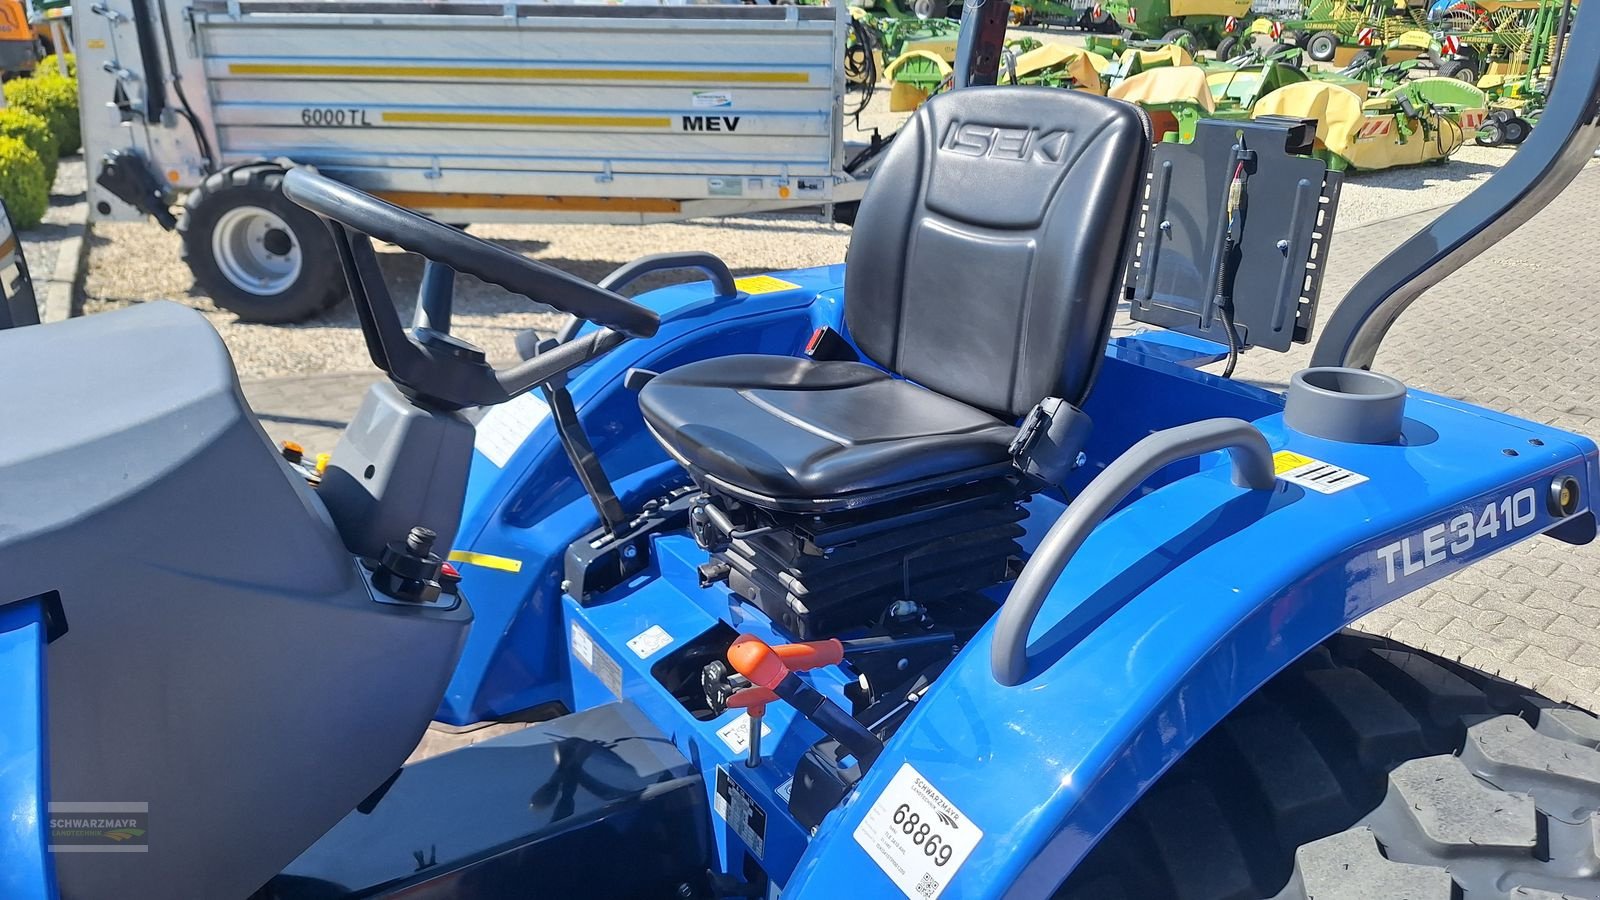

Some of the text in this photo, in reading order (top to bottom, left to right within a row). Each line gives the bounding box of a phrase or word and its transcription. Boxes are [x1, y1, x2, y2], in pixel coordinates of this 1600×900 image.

[302, 108, 372, 126] 6000TL
[682, 116, 740, 132] MEV
[939, 118, 1074, 165] ISEKI
[914, 777, 960, 821] SCHWARZMAYR
[893, 803, 953, 867] 68869
